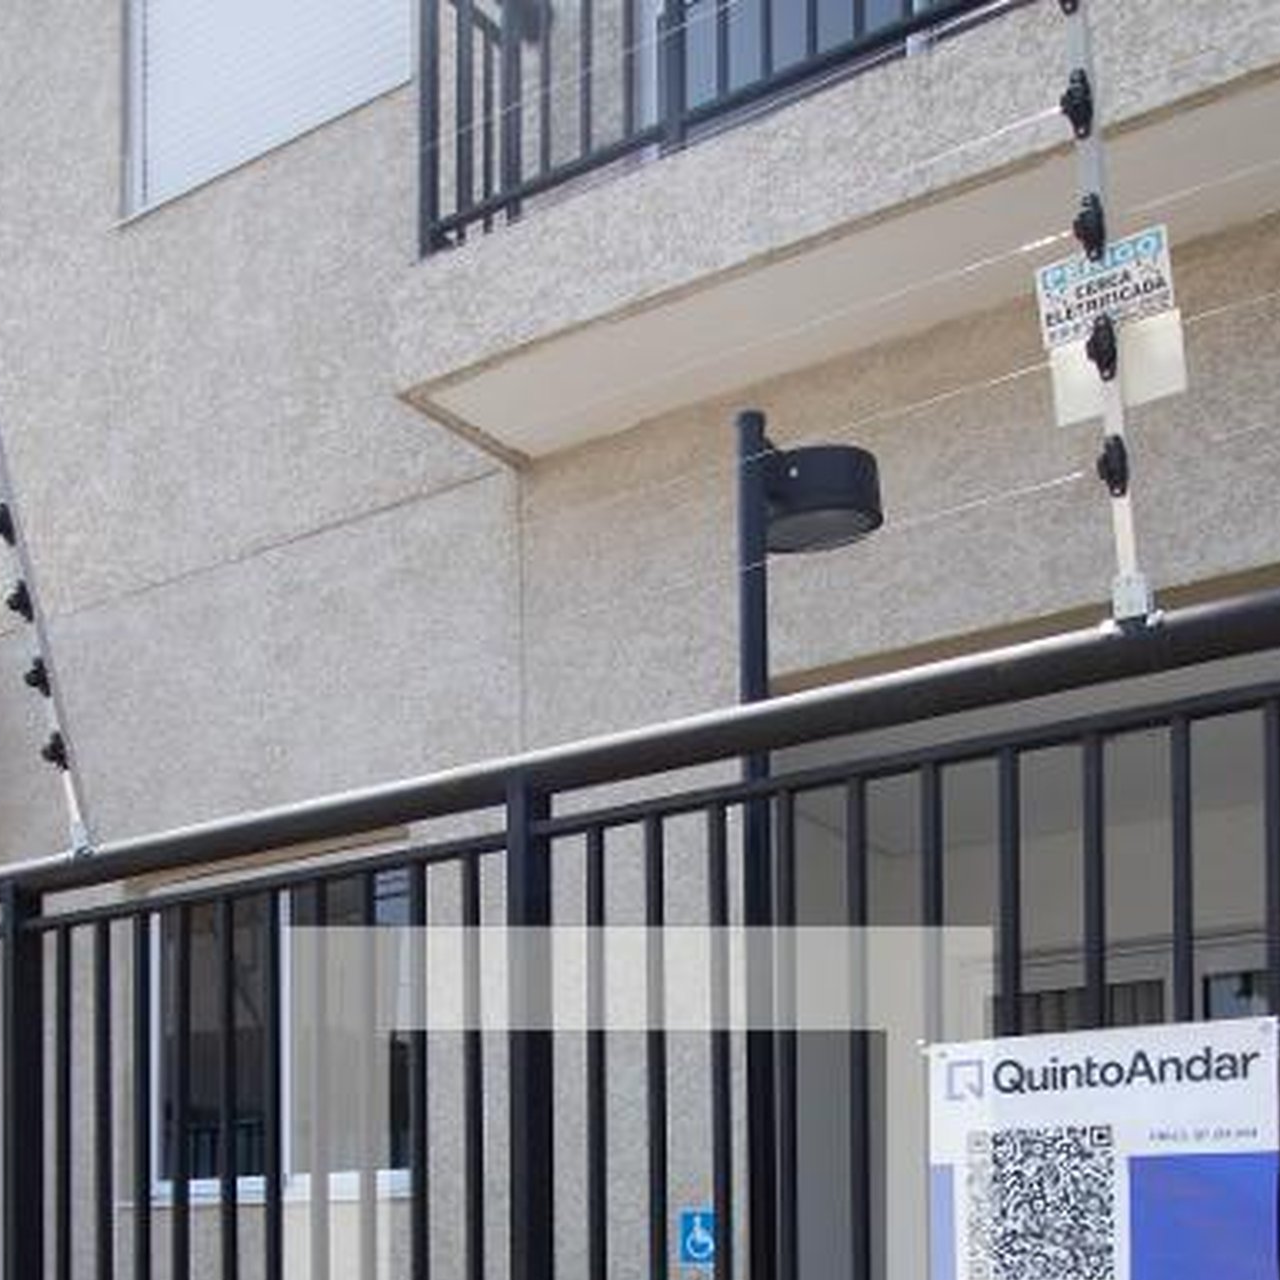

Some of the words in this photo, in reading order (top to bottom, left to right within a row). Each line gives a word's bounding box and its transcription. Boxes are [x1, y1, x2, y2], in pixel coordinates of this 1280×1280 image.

[1046, 276, 1168, 327] ELETRIFICADA
[1076, 269, 1131, 299] CERCA
[993, 1046, 1260, 1094] QuintoAndar
